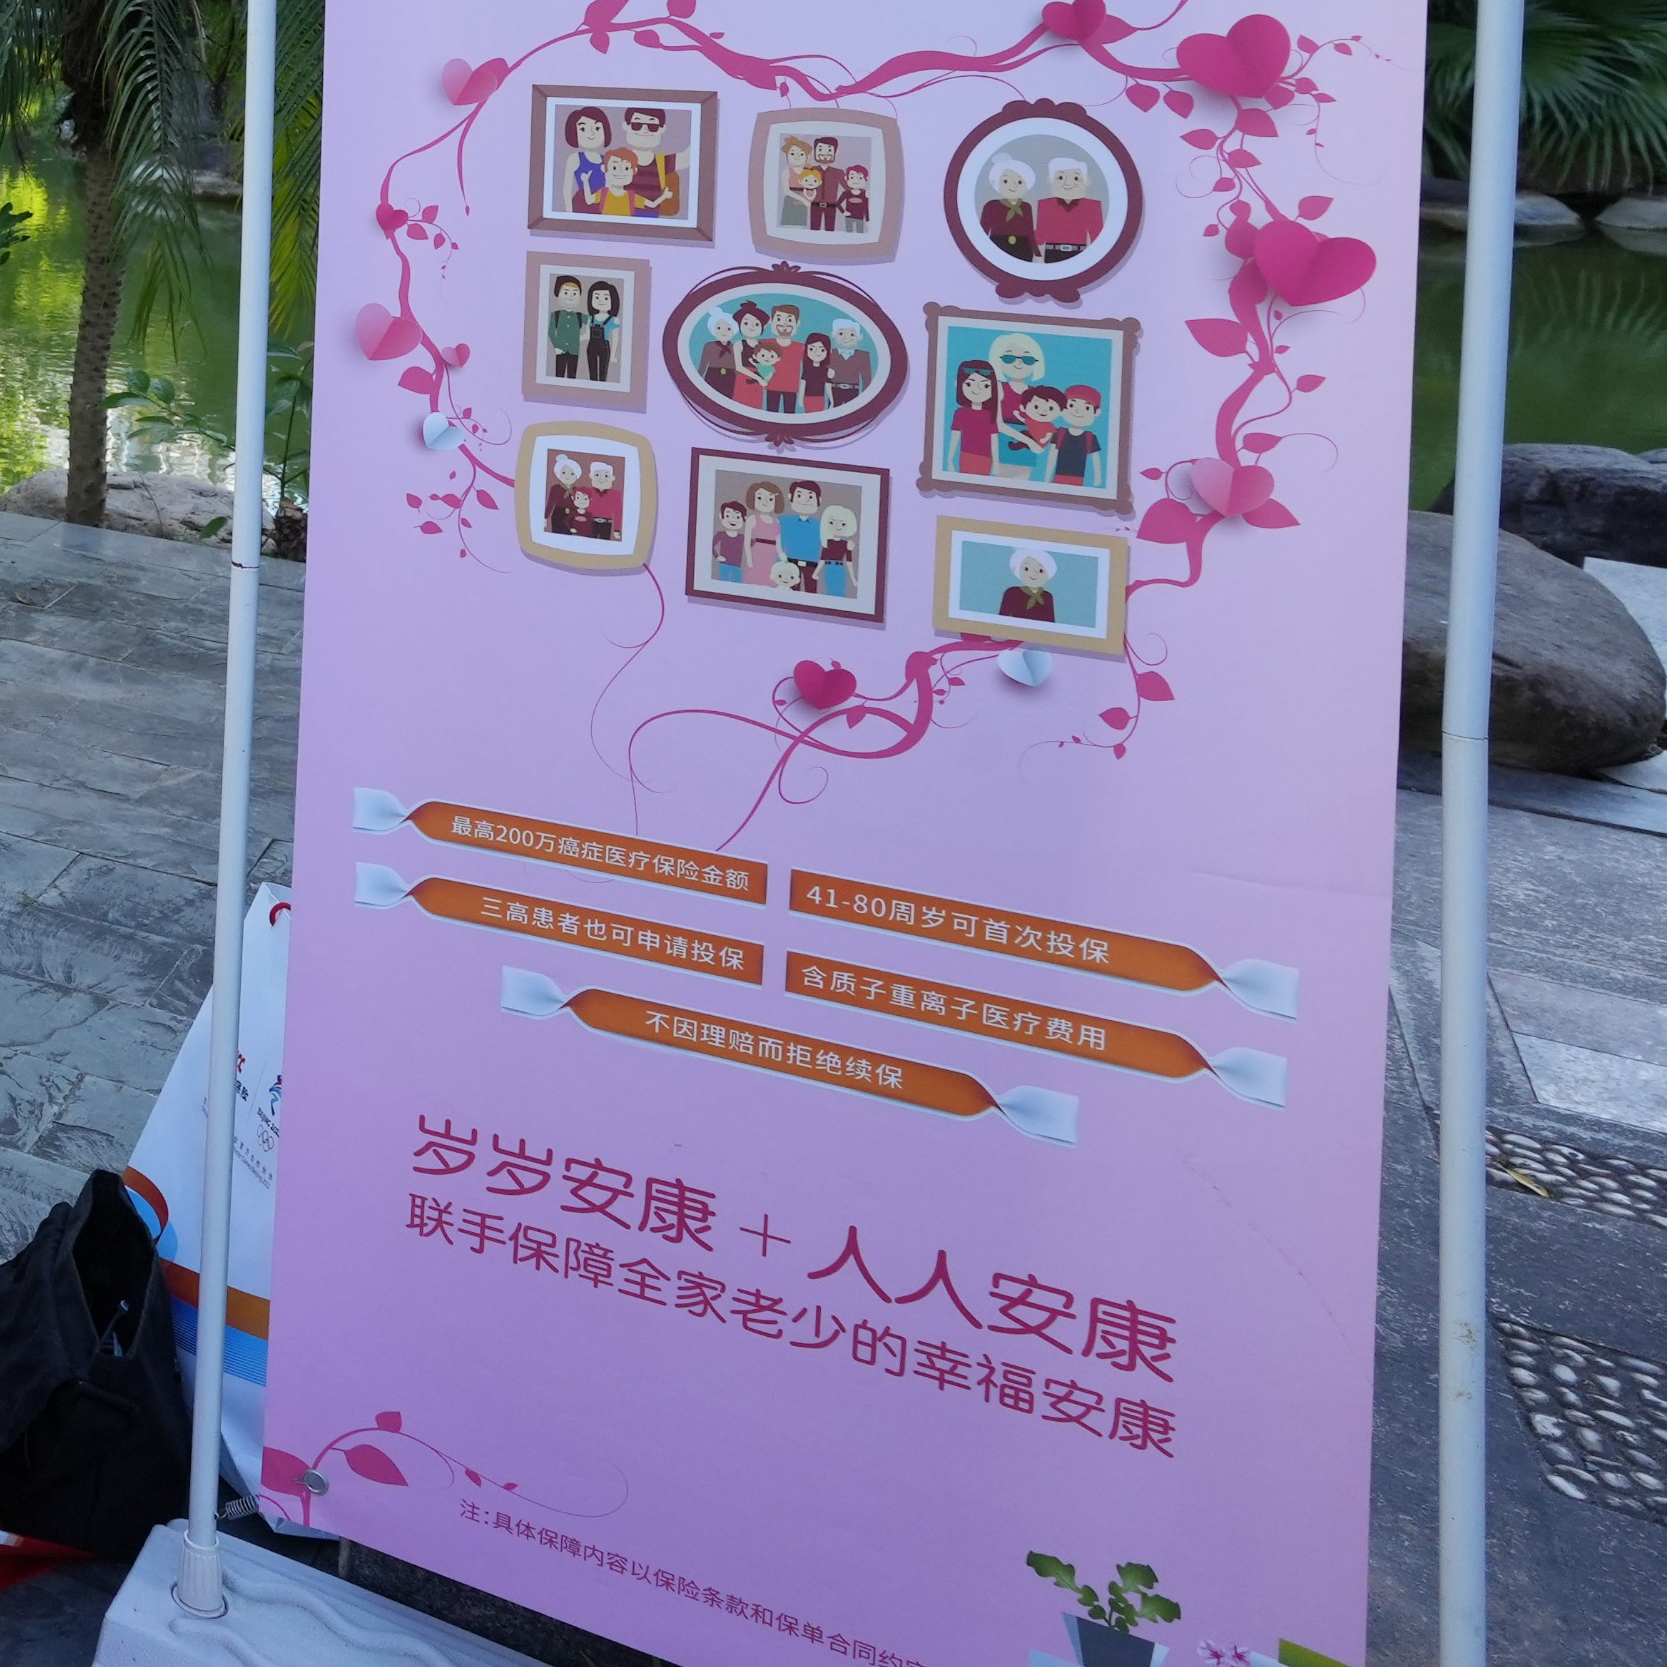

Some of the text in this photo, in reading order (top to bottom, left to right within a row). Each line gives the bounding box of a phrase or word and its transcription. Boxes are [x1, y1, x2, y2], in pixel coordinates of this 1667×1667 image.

[450, 813, 751, 895] 最高200万癌症医疗保险金额
[480, 893, 746, 973] 三高患者也可申请投保
[805, 883, 1112, 967] 41-80周岁可首次投保
[644, 1008, 905, 1092] 不因理赔而拒绝续保
[801, 962, 1107, 1054] 含质子重离子医疗费用
[410, 1114, 716, 1254] 岁岁安康
[807, 1225, 1178, 1384] 人人安康
[405, 1191, 1178, 1459] 联手保障全家老少的幸福安康
